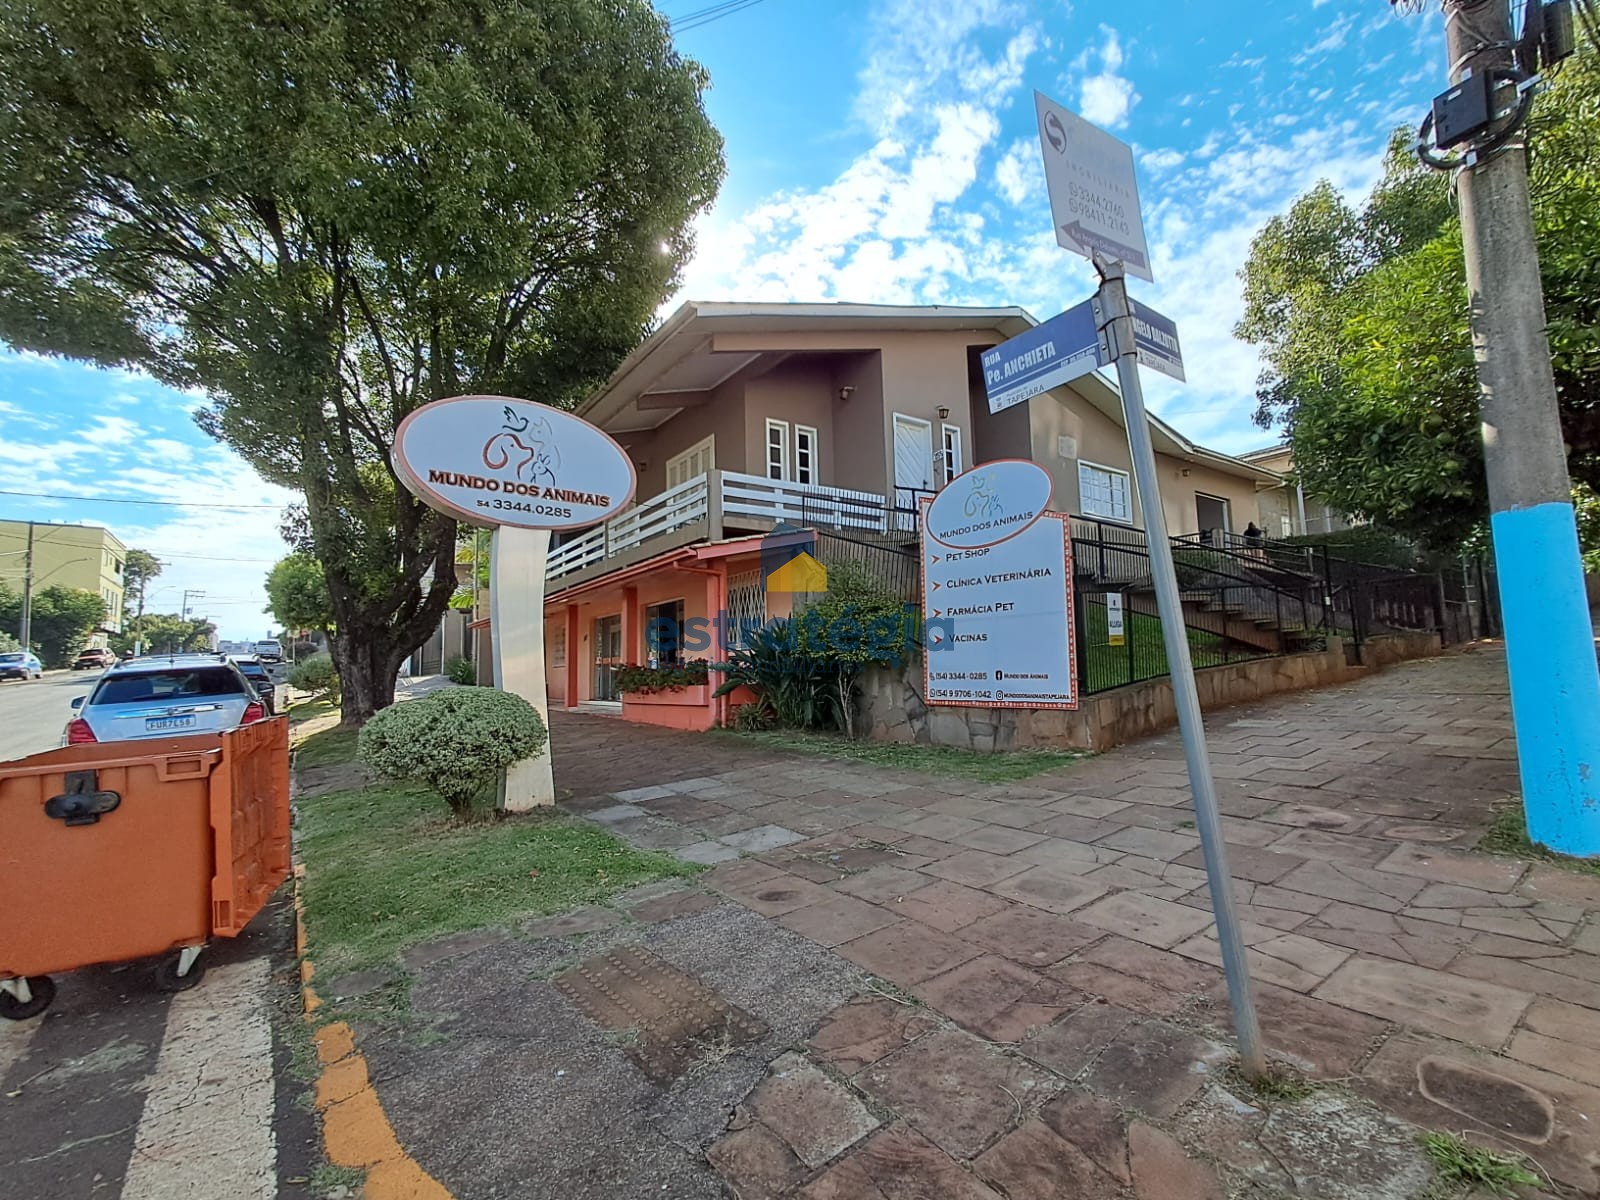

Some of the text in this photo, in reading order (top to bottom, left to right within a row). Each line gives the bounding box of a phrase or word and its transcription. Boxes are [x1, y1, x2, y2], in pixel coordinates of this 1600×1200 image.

[984, 352, 1001, 367] RUA
[986, 369, 1003, 385] Pe.
[1004, 341, 1056, 378] ANCHIETA
[1007, 384, 1045, 405] TAPEJARA
[428, 469, 611, 507] MUNDO DOS ANIMAIS
[476, 499, 572, 518] 54 3344.0285
[939, 511, 1034, 540] MUNDO DOS ANIMAIS
[936, 672, 948, 680] (54)
[936, 690, 948, 698] (54)
